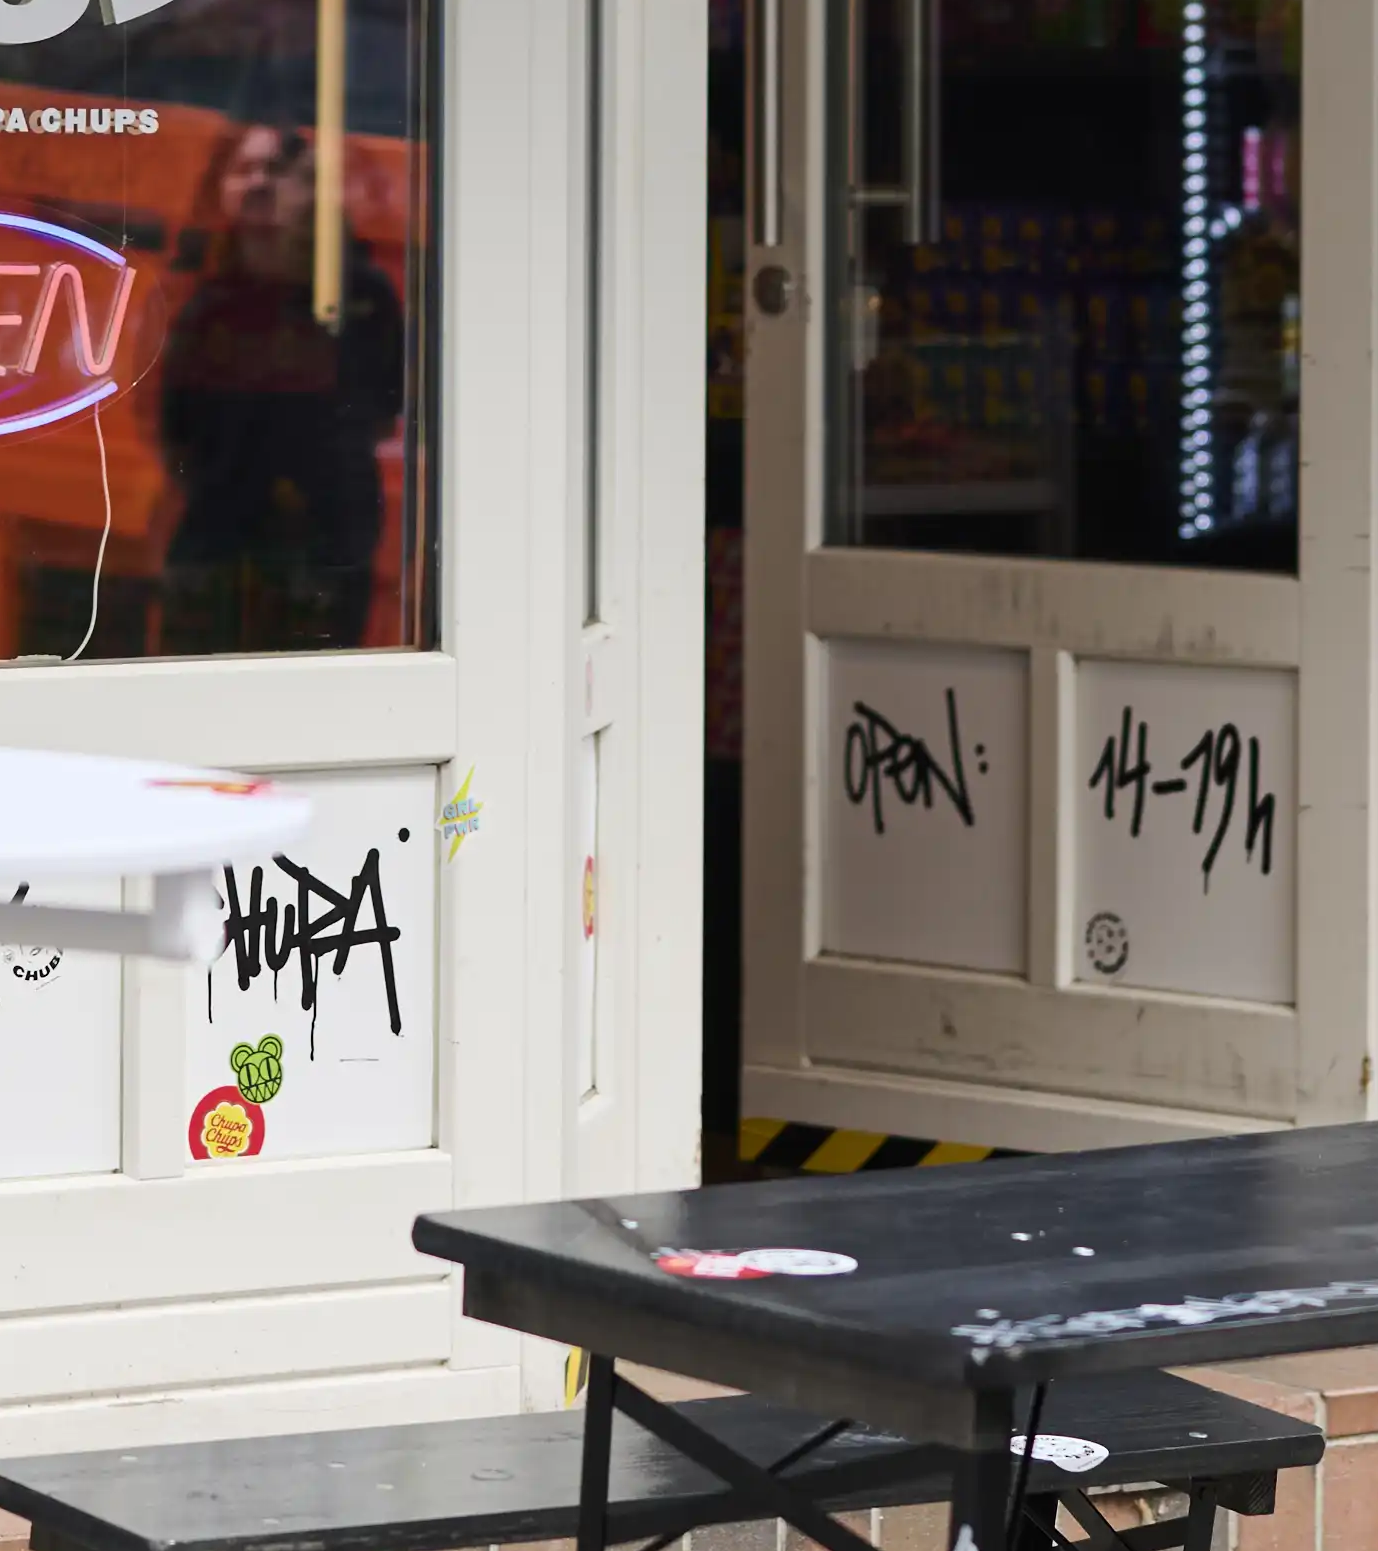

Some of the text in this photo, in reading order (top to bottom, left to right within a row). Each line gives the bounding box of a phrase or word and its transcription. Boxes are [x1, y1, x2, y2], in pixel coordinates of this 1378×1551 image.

[40, 107, 160, 134] CHUPS
[442, 797, 480, 821] GRL
[443, 816, 480, 840] PWR
[222, 848, 401, 1036] HUPA
[12, 952, 62, 981] CHUB
[210, 1113, 248, 1134] Chupa
[205, 1127, 243, 1154] Chups
